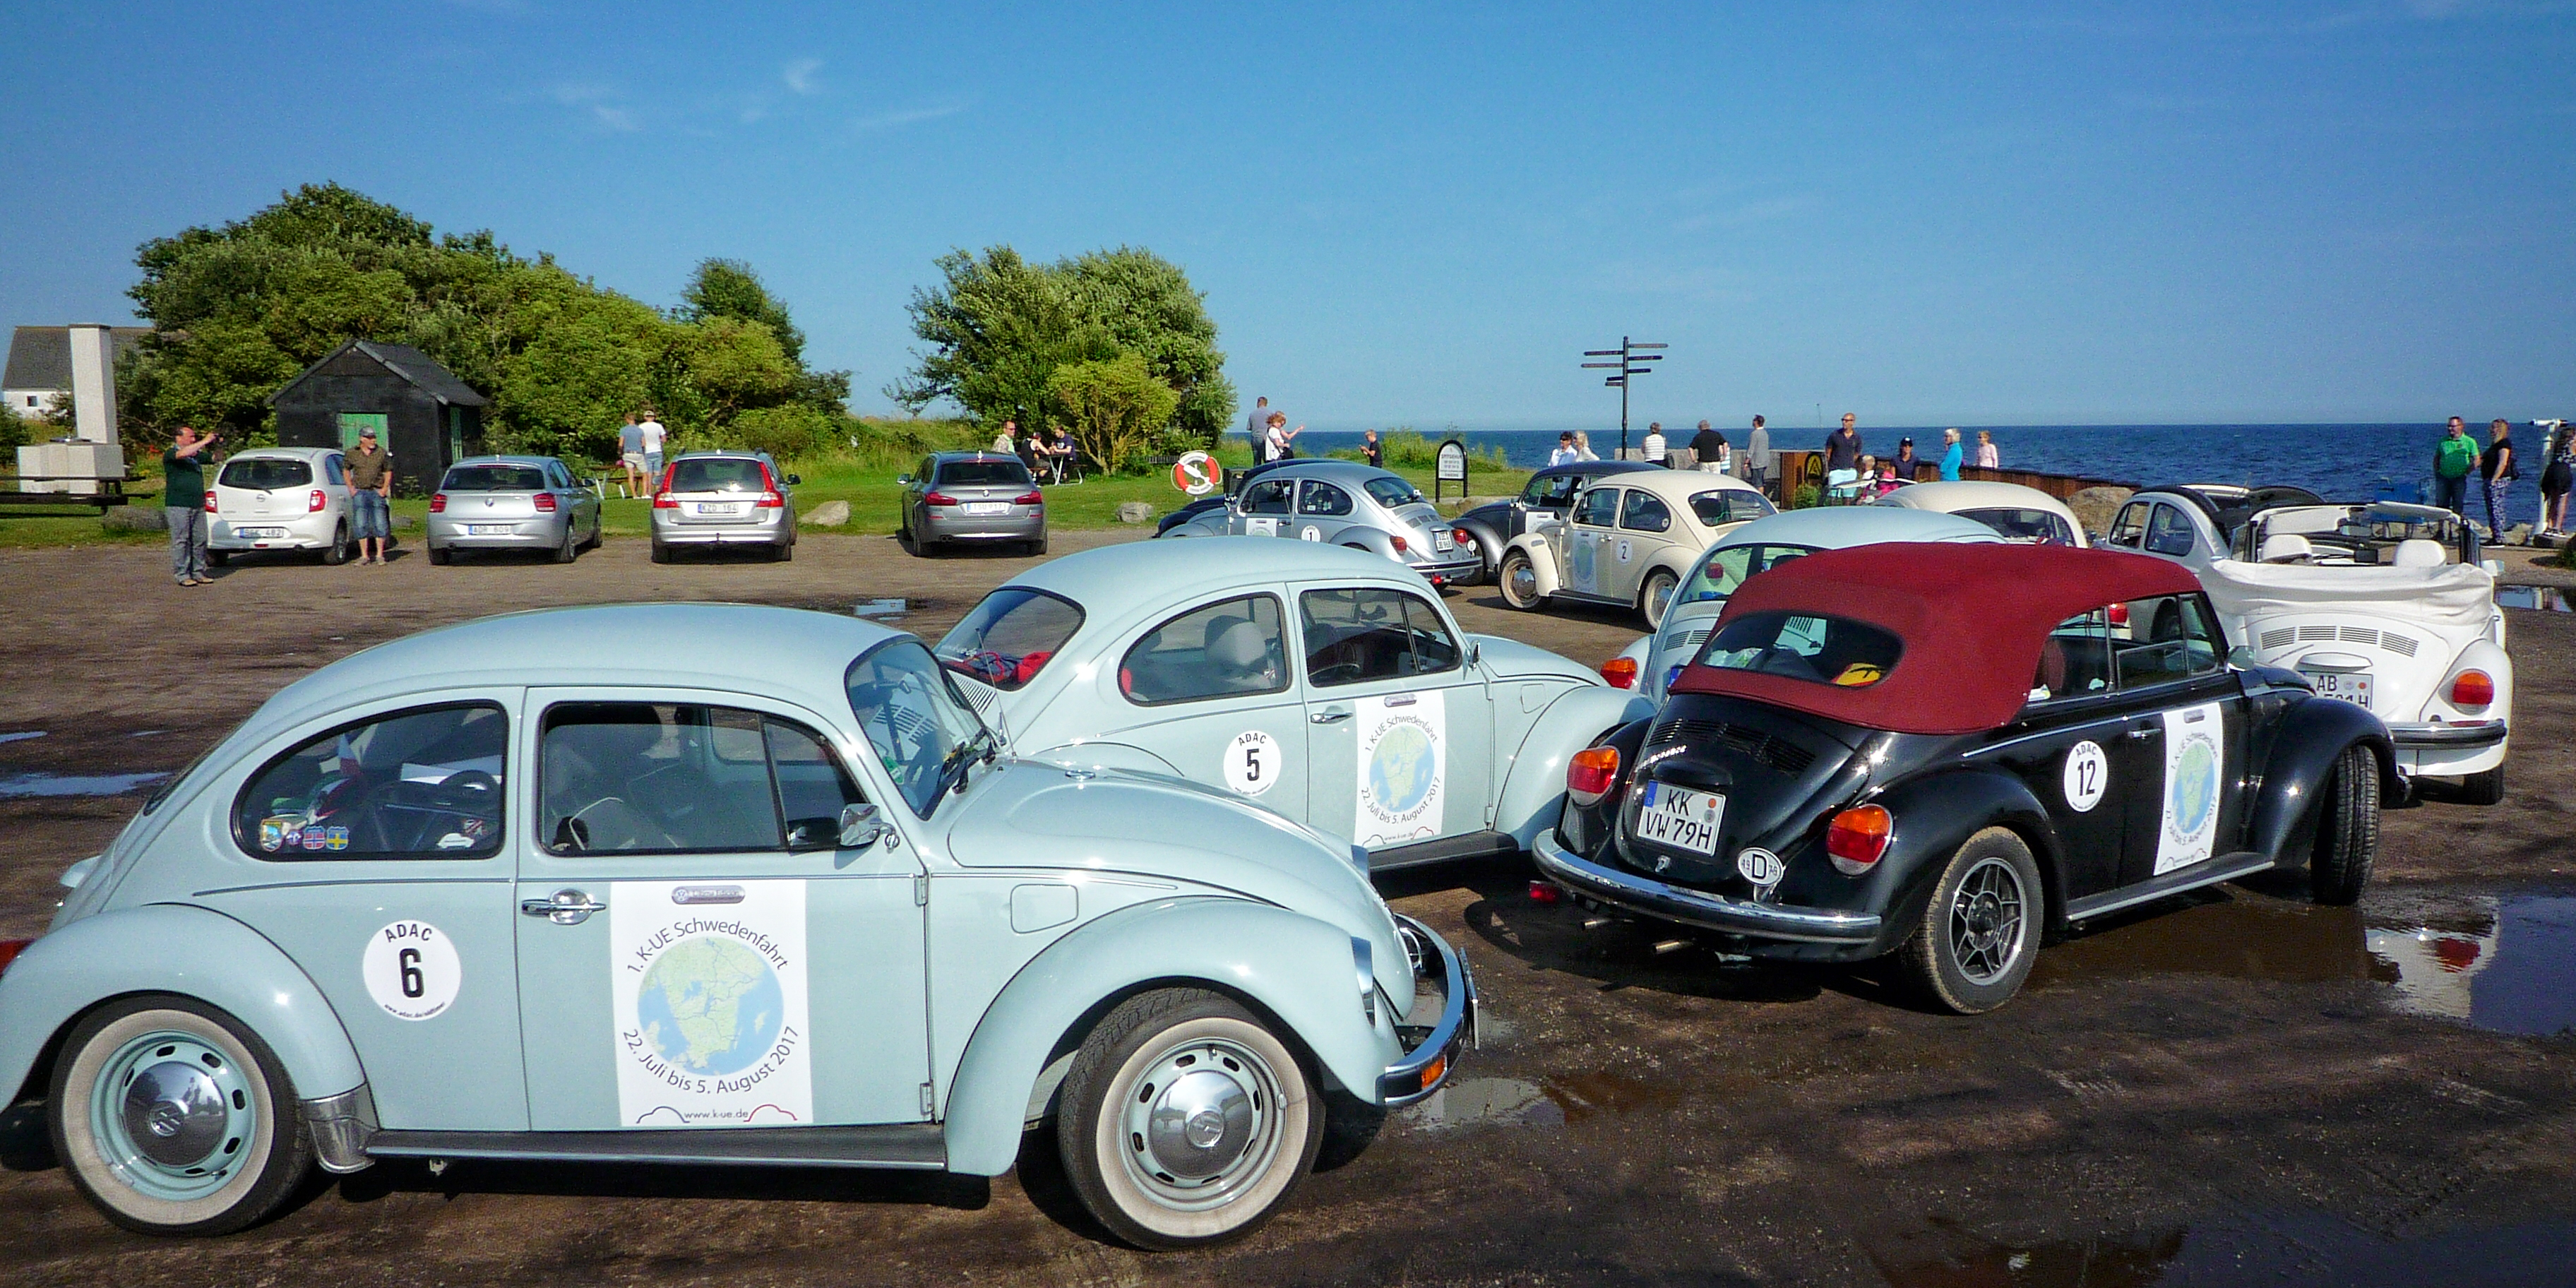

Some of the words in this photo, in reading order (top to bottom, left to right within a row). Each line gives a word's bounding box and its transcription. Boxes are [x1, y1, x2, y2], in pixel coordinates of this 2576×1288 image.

[1308, 532, 1312, 542] 1
[1622, 545, 1627, 559] 2
[2317, 675, 2337, 691] AB
[1239, 732, 1266, 746] ADAC
[1369, 722, 1387, 744] K-UE
[1386, 715, 1438, 743] Schwedenfahrt
[2076, 744, 2097, 758] ADAC
[1247, 749, 1260, 781] 5
[2077, 760, 2096, 797] 12
[1361, 787, 1371, 804] 22.
[1367, 801, 1380, 817] Juli
[1379, 811, 1390, 823] bis
[1392, 815, 1399, 824] 5.
[1401, 801, 1429, 823] August
[1426, 776, 1441, 801] 2017
[1666, 789, 1693, 816] KK
[1646, 811, 1670, 838] VW
[1673, 818, 1712, 849] 79H
[1752, 853, 1767, 880] D
[385, 924, 432, 943] ADAC
[627, 964, 643, 972] 1.
[636, 928, 674, 961] K-UE
[674, 917, 789, 970] Schwedenfahrt
[399, 948, 424, 998] 6
[623, 1028, 643, 1054] 22.
[638, 1054, 668, 1078] Juli
[667, 1070, 691, 1091] bis
[696, 1079, 711, 1094] 5.
[716, 1062, 775, 1094] August
[770, 1026, 799, 1066] 2017
[684, 1109, 749, 1119] www.k-ue.de
